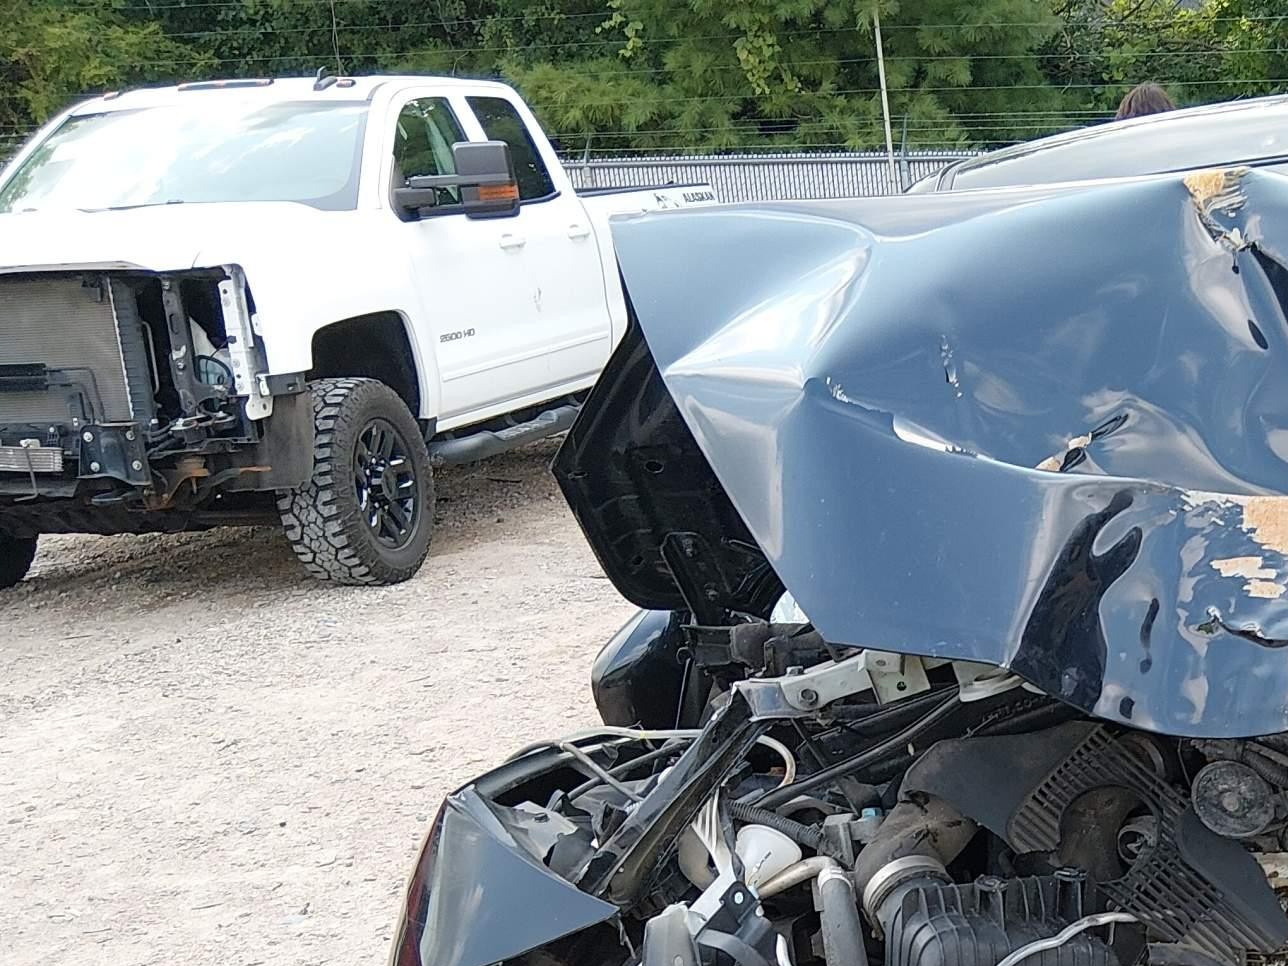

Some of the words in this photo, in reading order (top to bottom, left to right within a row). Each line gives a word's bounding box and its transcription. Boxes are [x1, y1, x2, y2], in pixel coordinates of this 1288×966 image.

[682, 191, 716, 203] ALASKAN
[440, 331, 462, 343] 2500
[463, 328, 475, 338] HD
